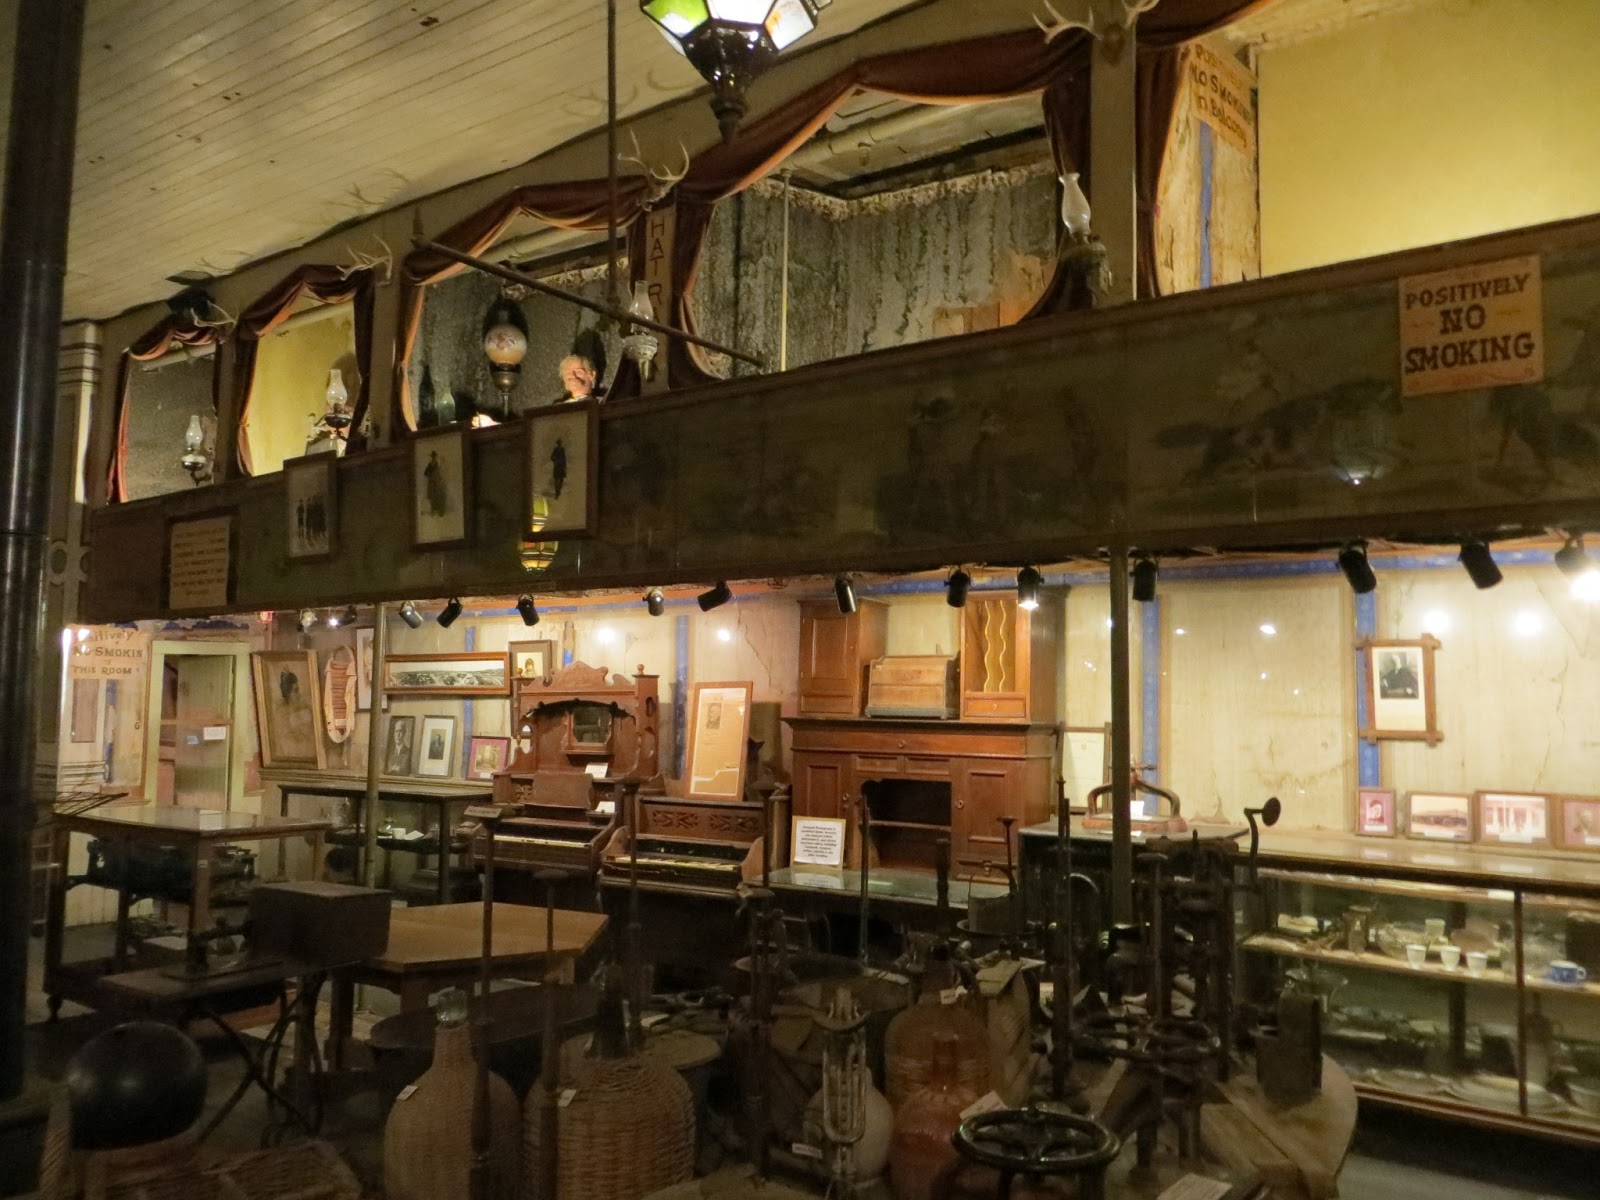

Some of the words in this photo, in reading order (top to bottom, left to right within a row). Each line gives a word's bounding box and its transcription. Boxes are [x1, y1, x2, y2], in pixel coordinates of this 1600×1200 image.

[650, 215, 665, 276] HAT
[1406, 272, 1531, 310] POSITIVELY
[1439, 303, 1486, 335] NO
[1404, 332, 1535, 375] SMOKING
[101, 666, 132, 676] ROOM
